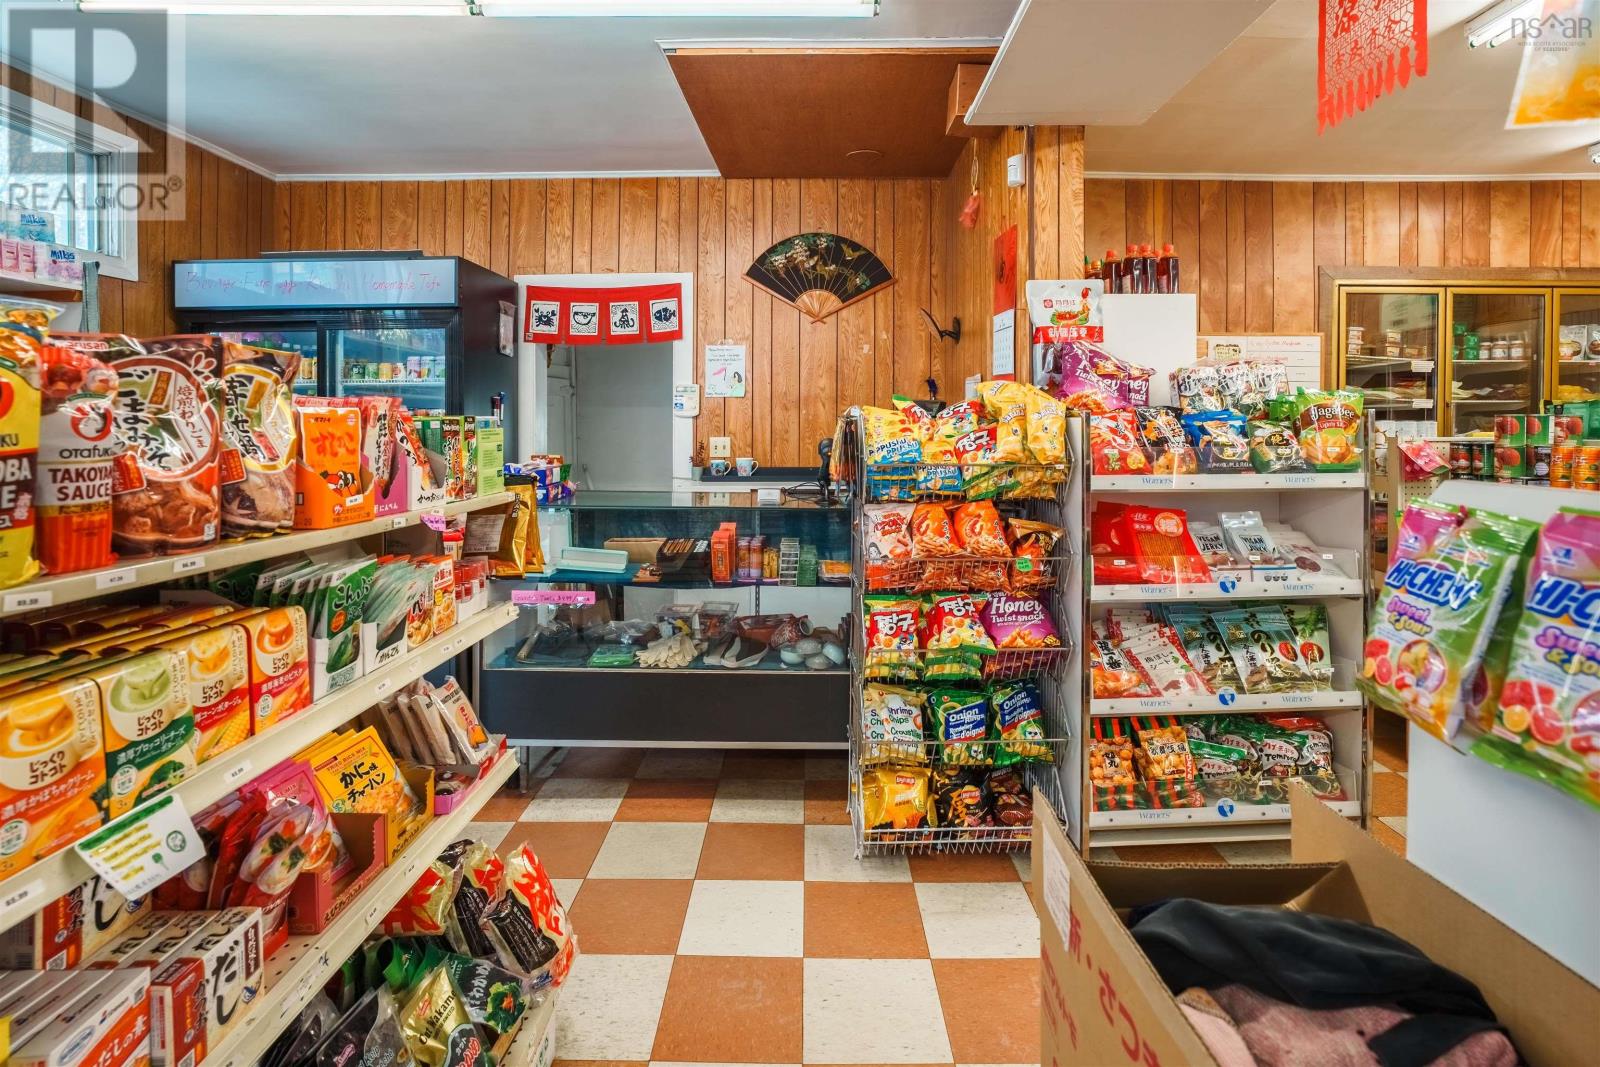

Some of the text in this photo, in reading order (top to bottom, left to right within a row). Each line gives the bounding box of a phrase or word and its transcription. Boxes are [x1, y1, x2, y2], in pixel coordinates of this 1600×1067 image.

[51, 249, 75, 260] Milkis
[57, 482, 110, 502] SAUCE
[1385, 557, 1483, 611] HI-CHEW
[991, 597, 1043, 615] Honey
[874, 613, 914, 635] 짱구
[991, 611, 1045, 623] Twist snack
[272, 662, 290, 674] コトコト
[202, 680, 224, 695] じっくり
[202, 689, 224, 704] コトコト
[1003, 691, 1027, 710] Onion
[138, 708, 163, 727] じっくり
[949, 707, 979, 723] Onion
[137, 720, 164, 737] コトコト
[29, 750, 65, 774] じっくり
[28, 763, 67, 785] コトコト
[347, 772, 386, 803] チャーハン
[427, 990, 457, 1032] Wakame
